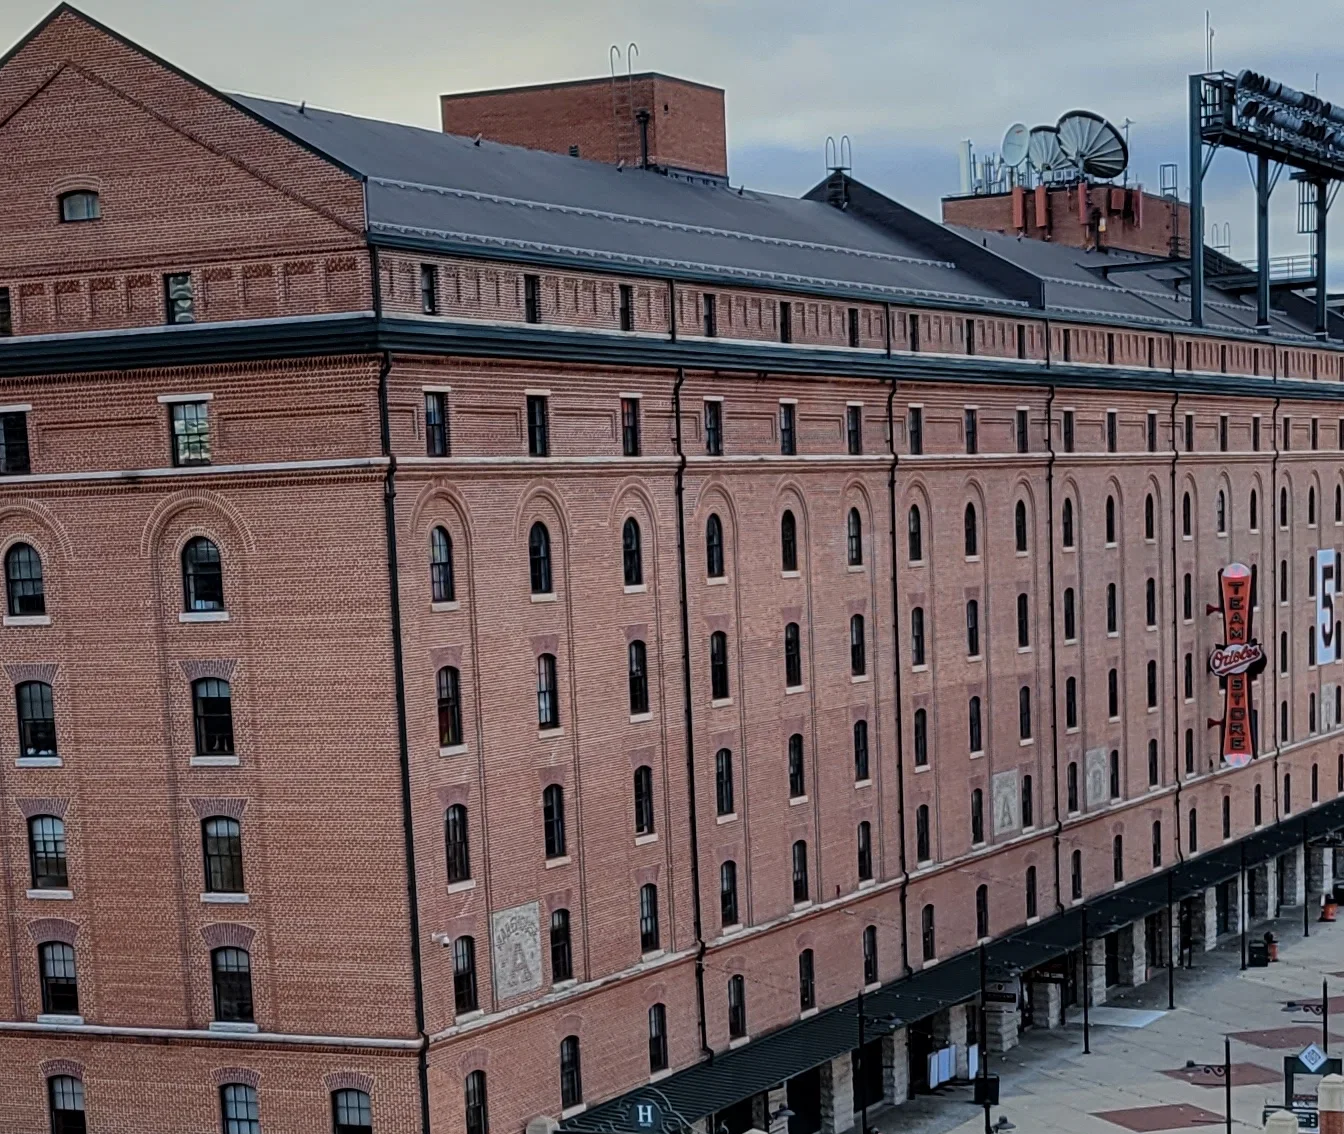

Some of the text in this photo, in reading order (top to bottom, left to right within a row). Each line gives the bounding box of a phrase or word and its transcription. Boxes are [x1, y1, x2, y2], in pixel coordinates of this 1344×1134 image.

[1228, 581, 1245, 641] TEAM
[1321, 564, 1334, 648] 5
[1211, 645, 1261, 671] Orioles
[1230, 679, 1246, 750] STORE
[637, 1104, 653, 1124] H
